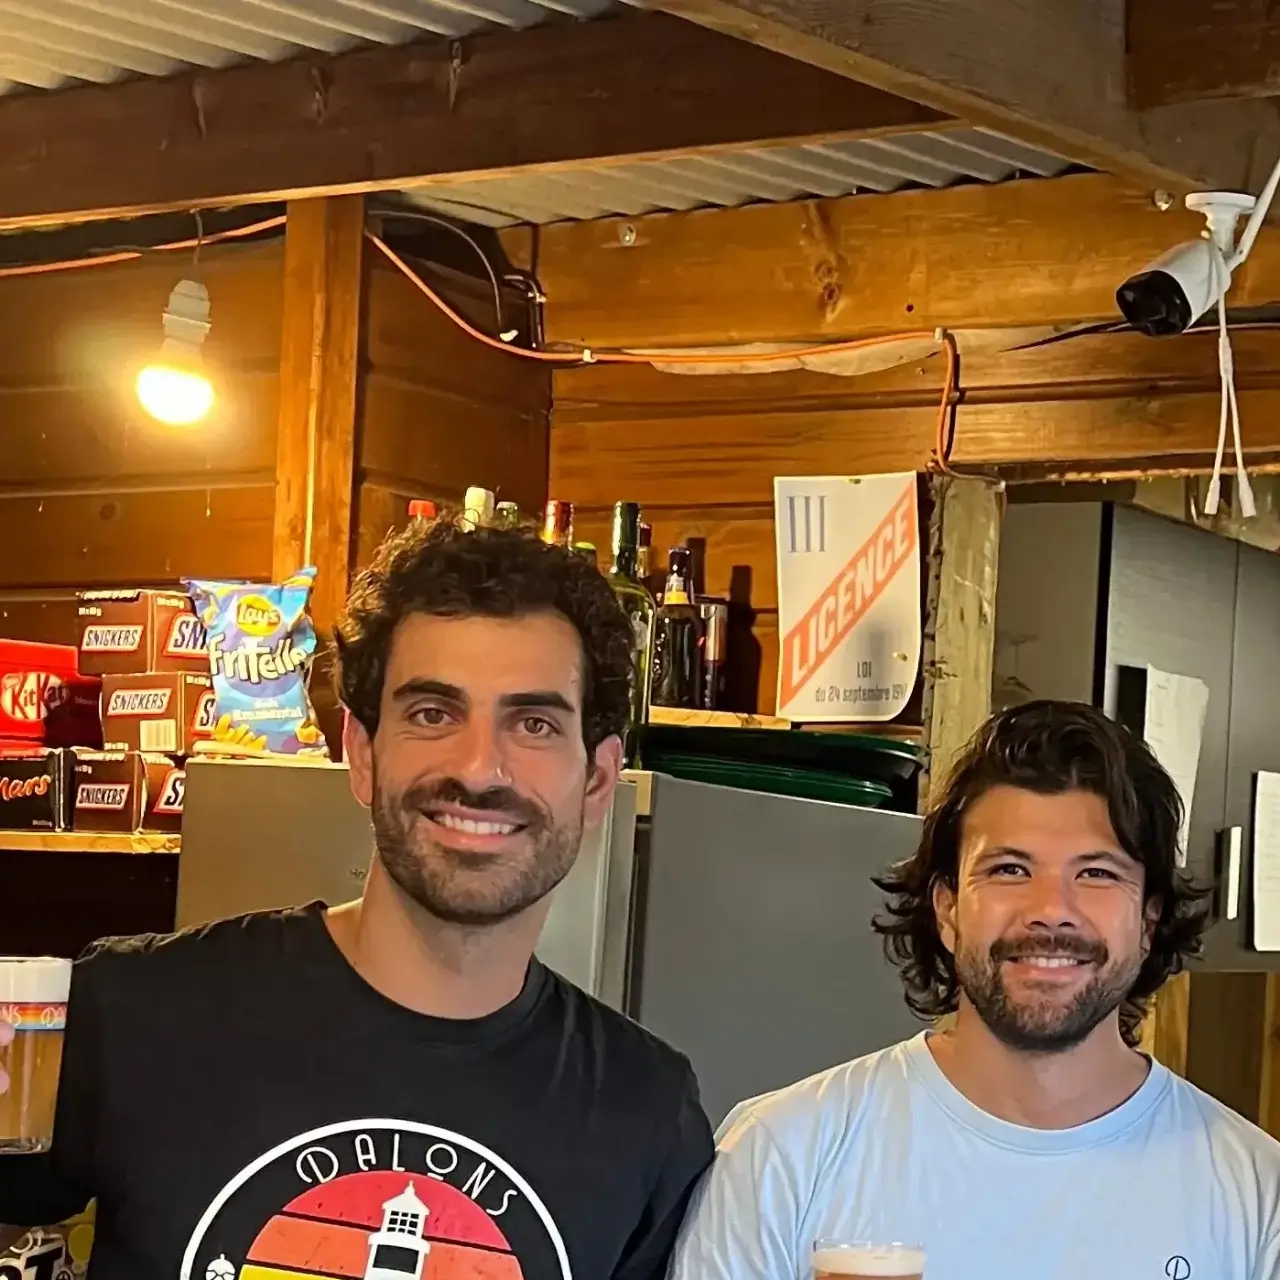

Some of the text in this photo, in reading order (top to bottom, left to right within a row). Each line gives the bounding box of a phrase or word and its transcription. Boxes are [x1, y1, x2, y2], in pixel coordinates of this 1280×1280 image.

[790, 498, 912, 689] LICENCE
[85, 628, 139, 647] SNICKERS
[856, 660, 873, 679] LOI
[111, 693, 167, 711] SNICKERS
[828, 685, 841, 702] 24
[842, 682, 890, 704] septembre
[78, 786, 126, 806] SNICKERS
[295, 1133, 518, 1216] DALONS
